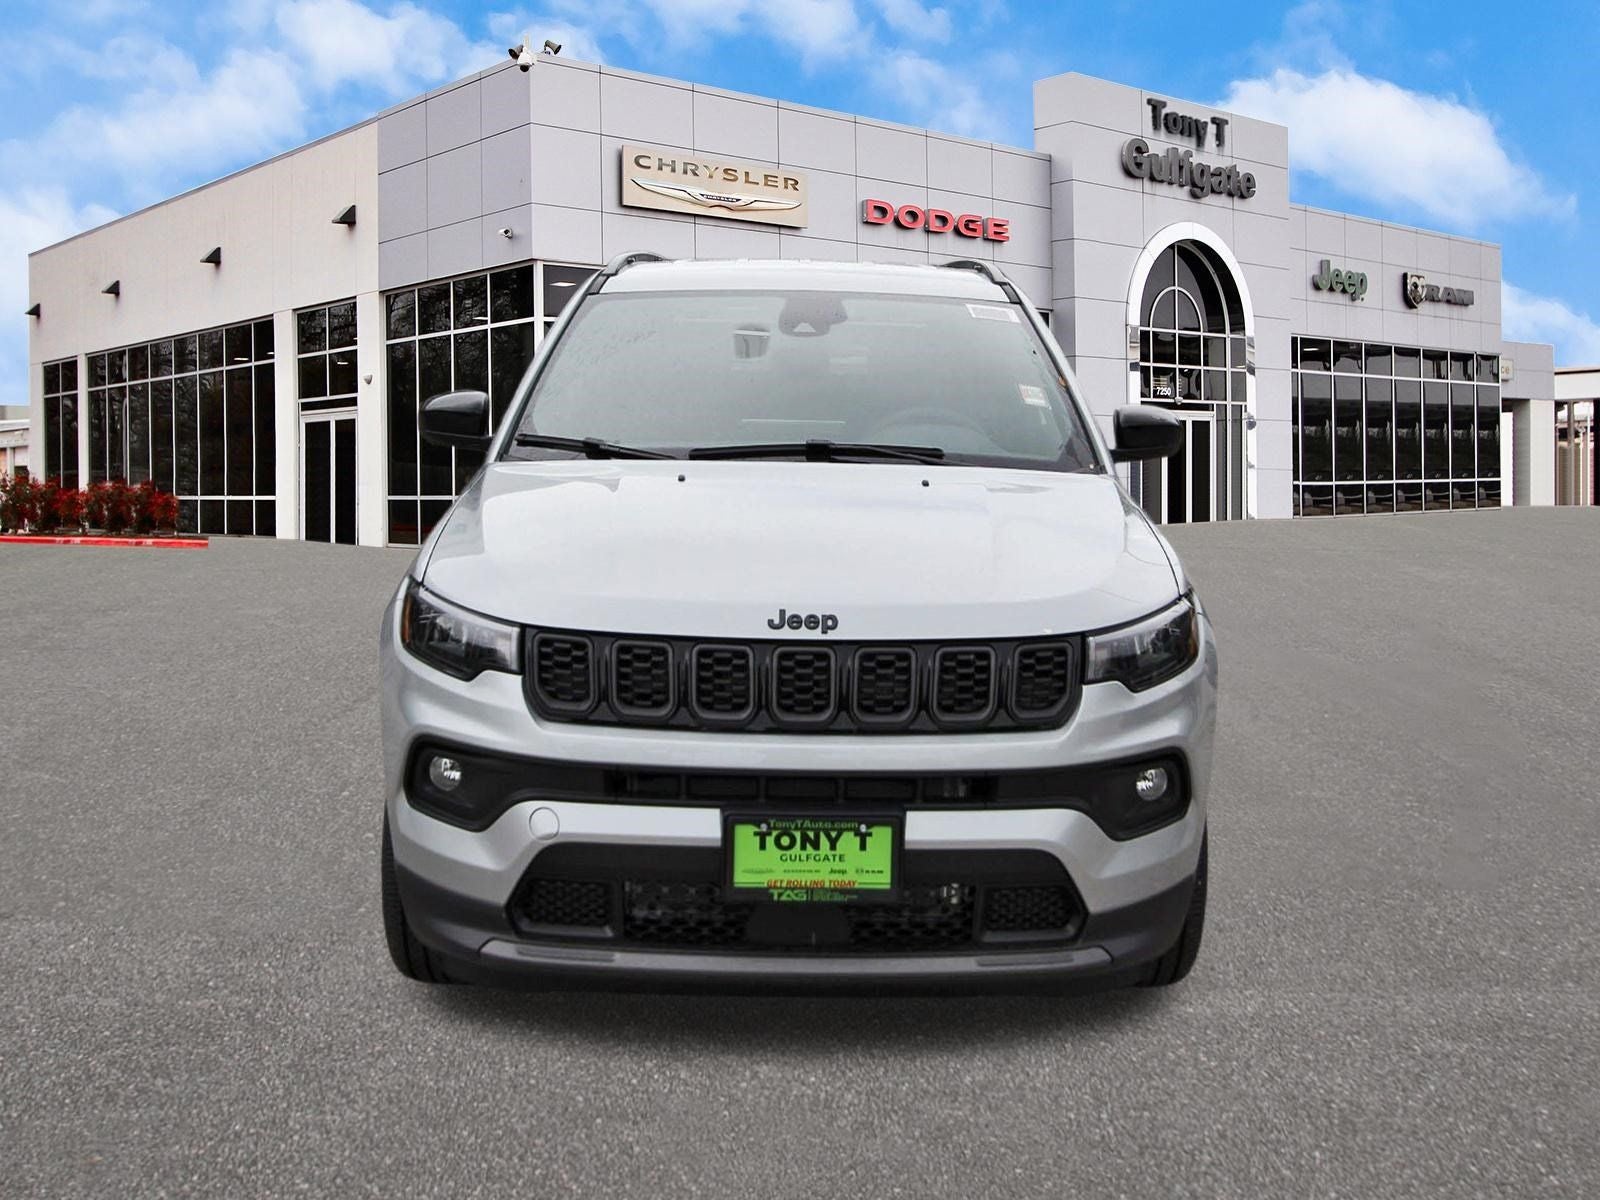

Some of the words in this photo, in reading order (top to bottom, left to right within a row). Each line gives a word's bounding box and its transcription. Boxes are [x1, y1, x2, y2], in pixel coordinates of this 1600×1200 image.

[1146, 98, 1208, 148] Tony
[1210, 116, 1229, 148] T
[633, 154, 800, 192] CHRYSLER
[1121, 138, 1256, 199] Gulfgate
[862, 198, 1010, 242] DODGE
[1312, 259, 1368, 301] Jeep
[1424, 283, 1475, 307] RAM
[1156, 387, 1172, 396] 7250
[767, 609, 839, 634] Jeep
[753, 829, 844, 851] TONY
[853, 830, 873, 851] T
[779, 853, 845, 863] GULFGATE
[766, 879, 785, 888] GET
[786, 879, 825, 888] ROLLING
[828, 879, 857, 888] TODAY
